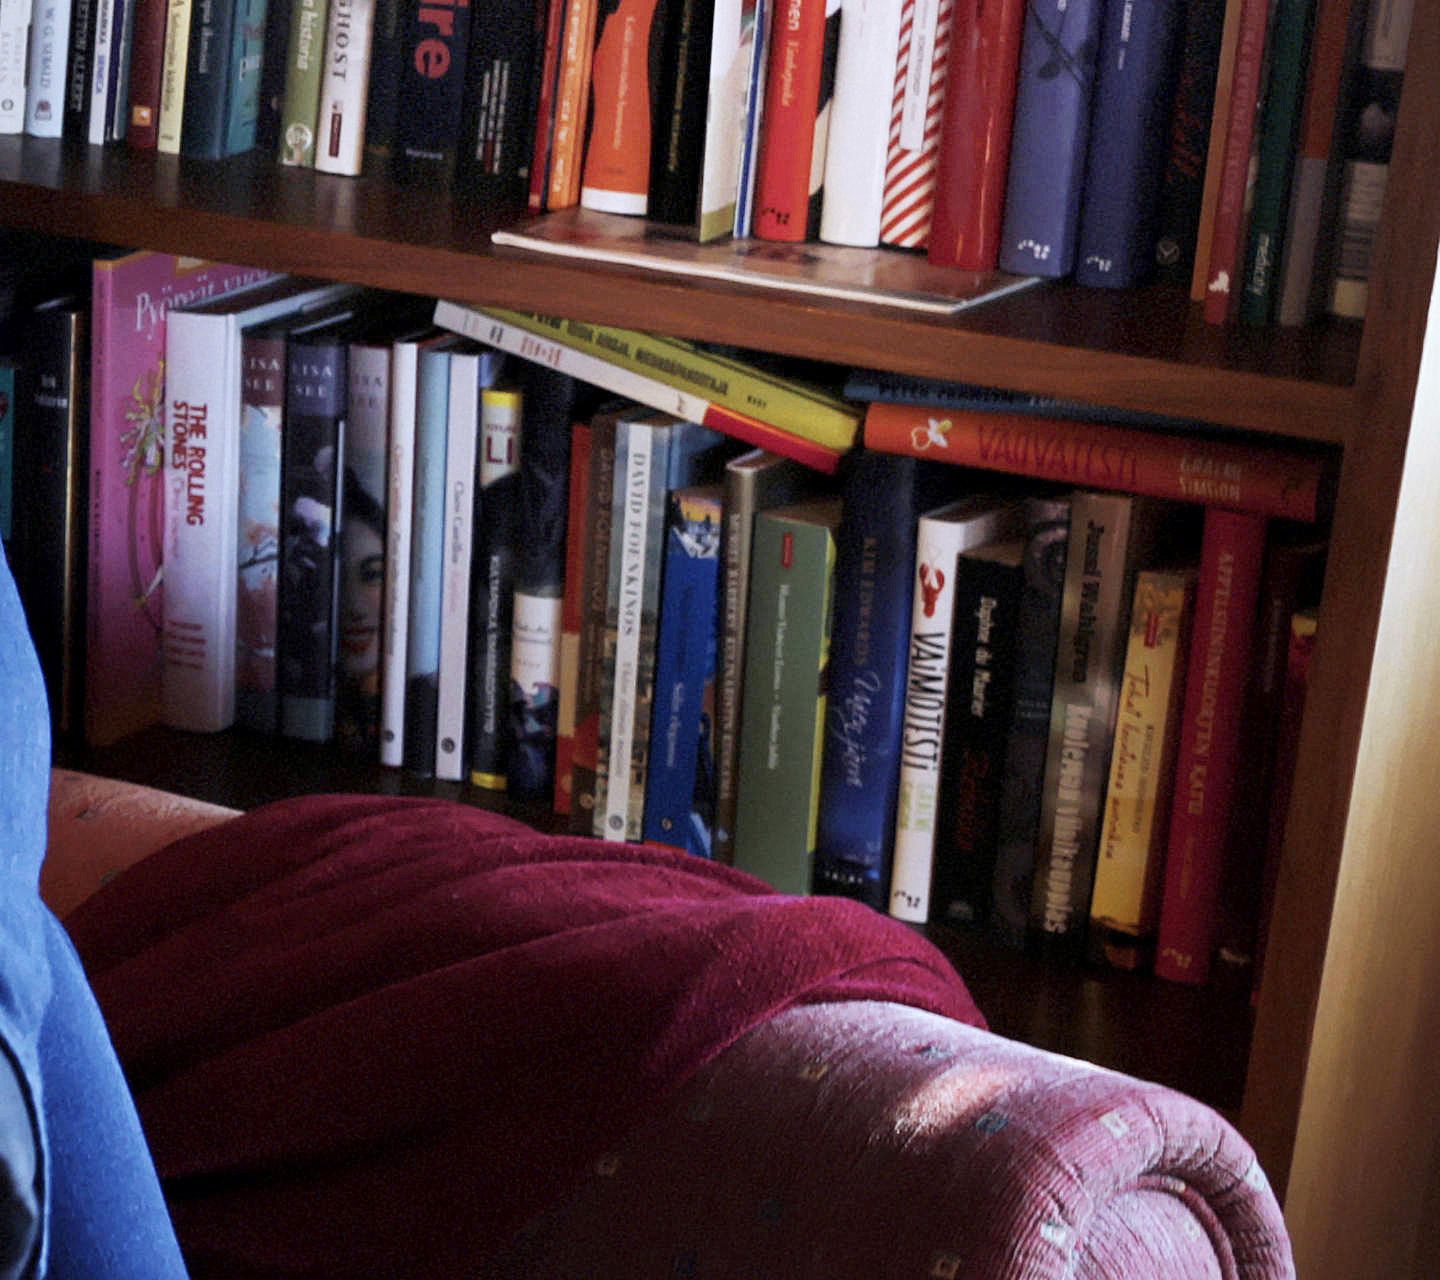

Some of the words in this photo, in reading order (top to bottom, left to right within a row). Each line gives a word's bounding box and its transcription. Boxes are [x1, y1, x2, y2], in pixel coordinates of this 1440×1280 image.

[172, 400, 189, 471] STONES
[188, 403, 208, 441] THE
[186, 445, 208, 527] ROLLING
[631, 451, 647, 514] DAVID
